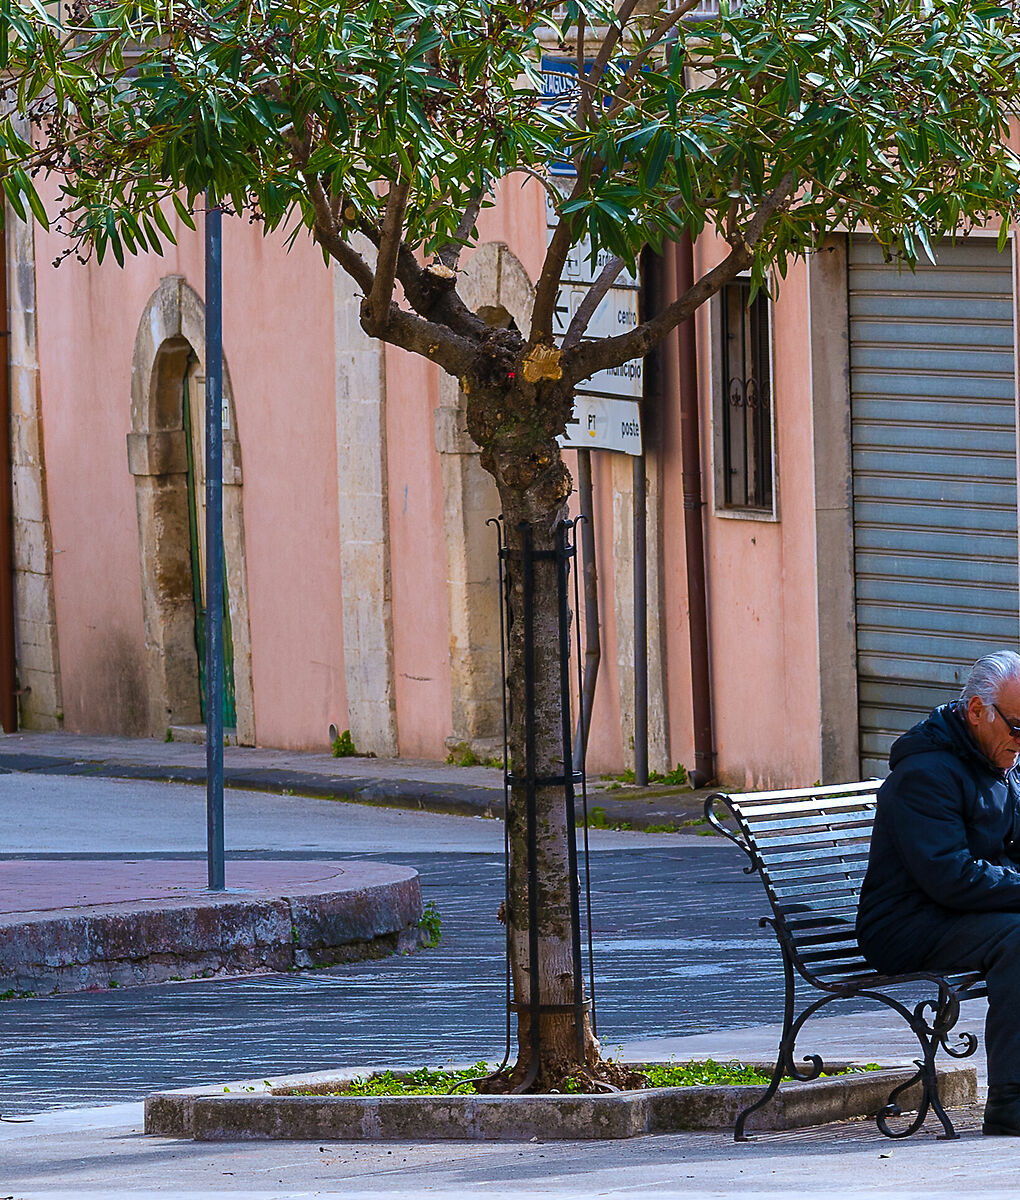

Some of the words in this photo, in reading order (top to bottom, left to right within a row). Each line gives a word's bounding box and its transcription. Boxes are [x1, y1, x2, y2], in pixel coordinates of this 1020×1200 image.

[617, 307, 637, 326] centro
[588, 414, 596, 430] PT
[621, 419, 640, 438] poste
